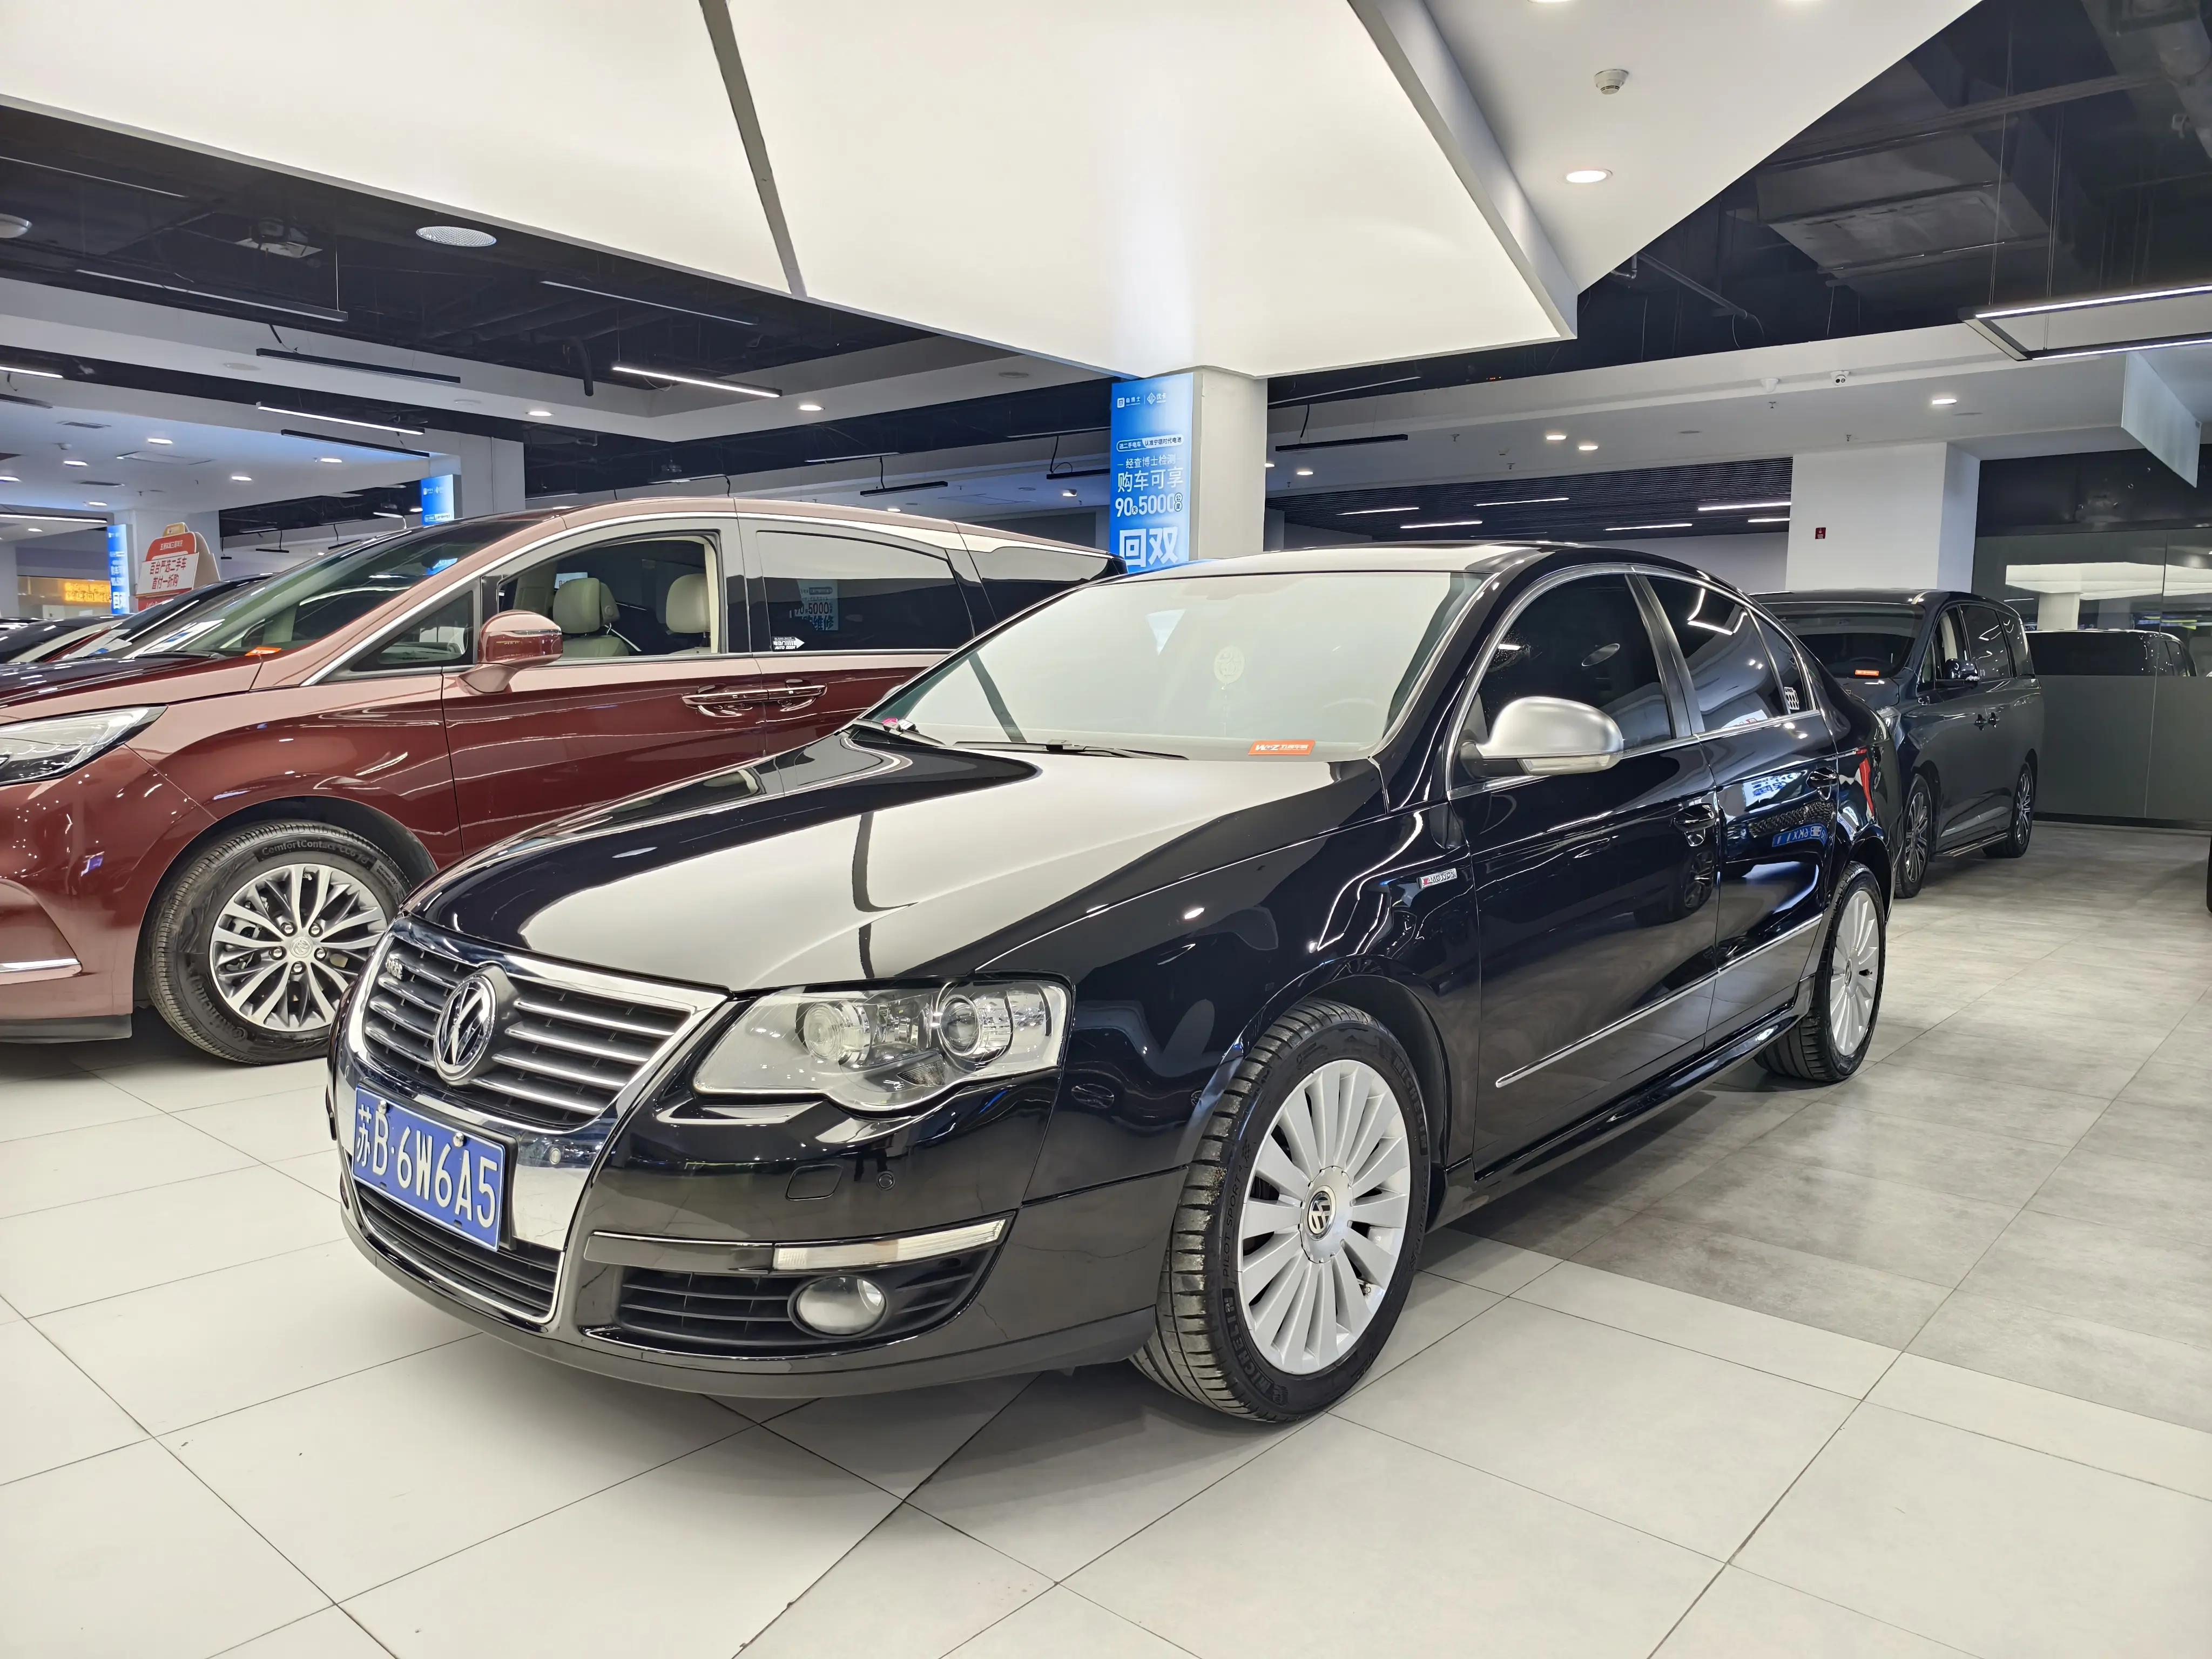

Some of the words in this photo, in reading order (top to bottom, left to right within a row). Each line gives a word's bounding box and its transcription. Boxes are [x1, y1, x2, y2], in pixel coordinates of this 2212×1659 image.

[1125, 454, 1176, 469] 经查博士检测
[1117, 467, 1184, 493] 购车可享
[1120, 527, 1178, 568] 回双
[150, 556, 187, 575] 百台严选二手车
[152, 574, 179, 590] 首付一折购
[356, 1103, 498, 1229] 苏B·6W6A5
[1226, 1175, 1240, 1228] SPORT
